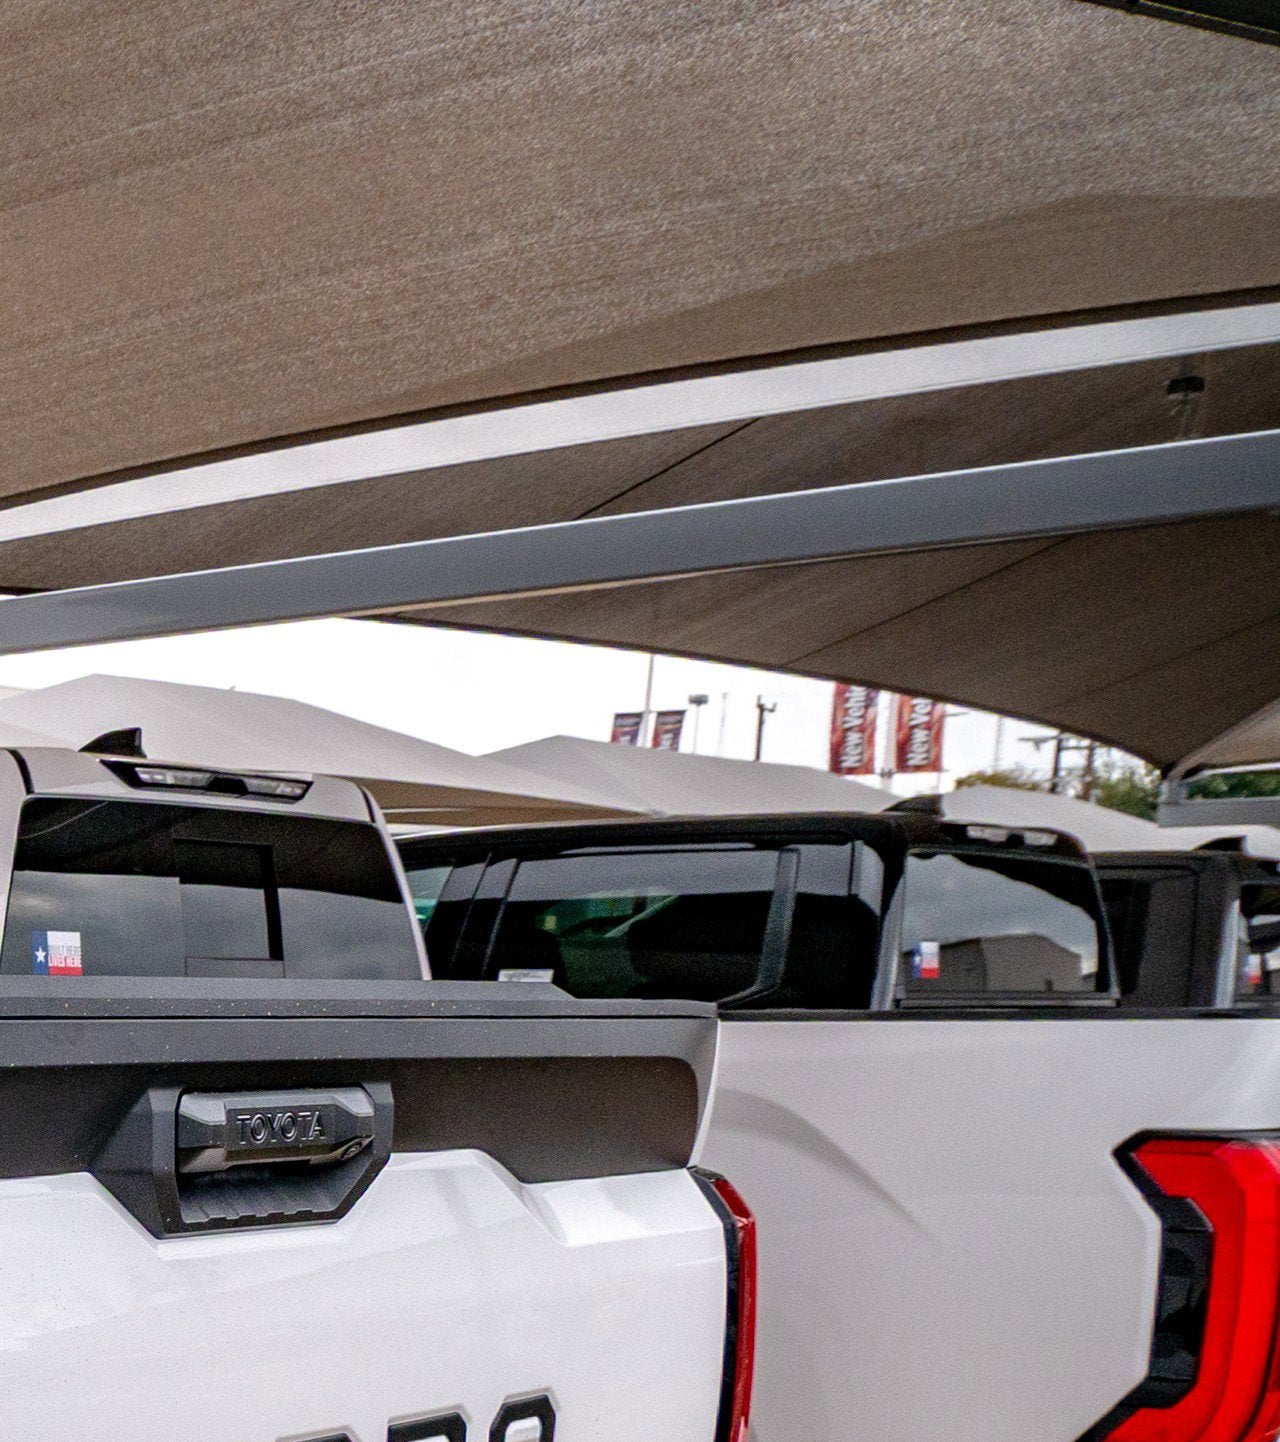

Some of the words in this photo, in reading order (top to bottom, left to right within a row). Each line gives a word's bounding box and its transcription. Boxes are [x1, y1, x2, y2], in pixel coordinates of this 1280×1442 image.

[840, 731, 864, 768] New
[906, 729, 930, 766] New
[236, 1111, 326, 1145] TOYOTA
